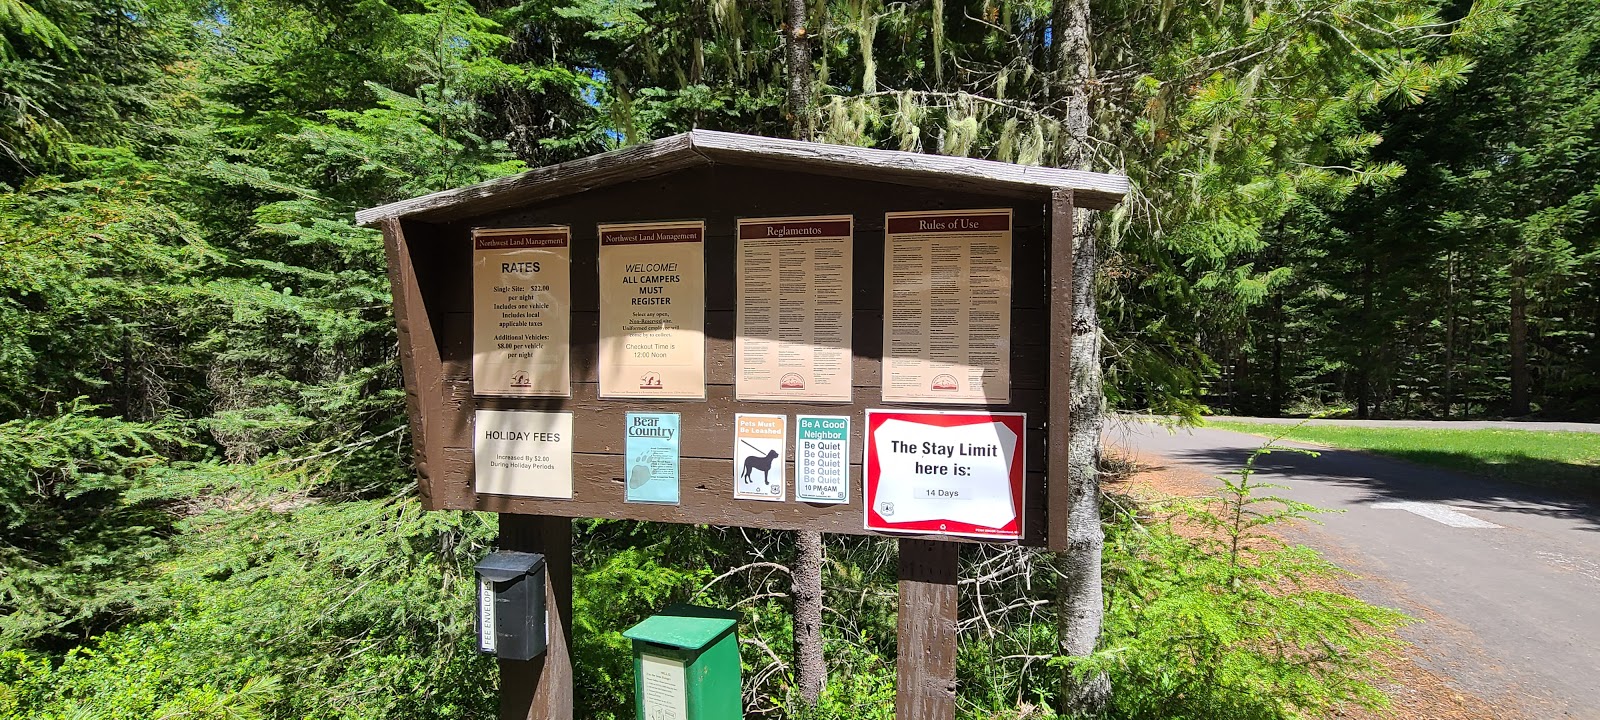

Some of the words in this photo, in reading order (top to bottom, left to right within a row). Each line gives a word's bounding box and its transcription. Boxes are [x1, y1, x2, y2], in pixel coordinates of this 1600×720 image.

[919, 219, 946, 230] Rules
[948, 218, 958, 230] of
[960, 218, 979, 229] Use
[766, 225, 822, 238] Reglamentos
[479, 239, 509, 247] Northwest
[510, 238, 524, 246] Land
[525, 237, 563, 246] Management
[605, 235, 638, 243] Northwest
[639, 233, 655, 241] Land
[656, 233, 697, 241] Management
[501, 262, 540, 273] RATES
[625, 263, 678, 273] WELCOME!
[622, 276, 638, 284] ALL
[640, 275, 680, 283] CAMPERS
[639, 286, 663, 294] MUST
[631, 297, 671, 305] REGISTER
[633, 416, 659, 427] Bear
[801, 420, 812, 428] Be
[814, 420, 820, 428] A
[822, 420, 845, 429] Good
[485, 430, 530, 441] HOLIDAY
[533, 432, 560, 442] FEES
[628, 426, 675, 441] Country
[804, 430, 842, 440] Neighbor
[804, 441, 815, 449] Be
[818, 442, 840, 450] Quiet
[891, 440, 918, 454] The
[922, 441, 954, 458] Stay
[960, 443, 998, 457] Limit
[804, 450, 815, 458] Be
[818, 450, 840, 459] Quiet
[510, 462, 531, 470] Holiday
[804, 458, 815, 466] Be
[818, 459, 840, 467] Quiet
[804, 467, 815, 475] Be
[818, 468, 840, 476] Quiet
[915, 462, 948, 476] here
[954, 463, 971, 476] is:
[804, 475, 815, 483] Be
[818, 476, 840, 484] Quiet
[938, 490, 959, 498] Days
